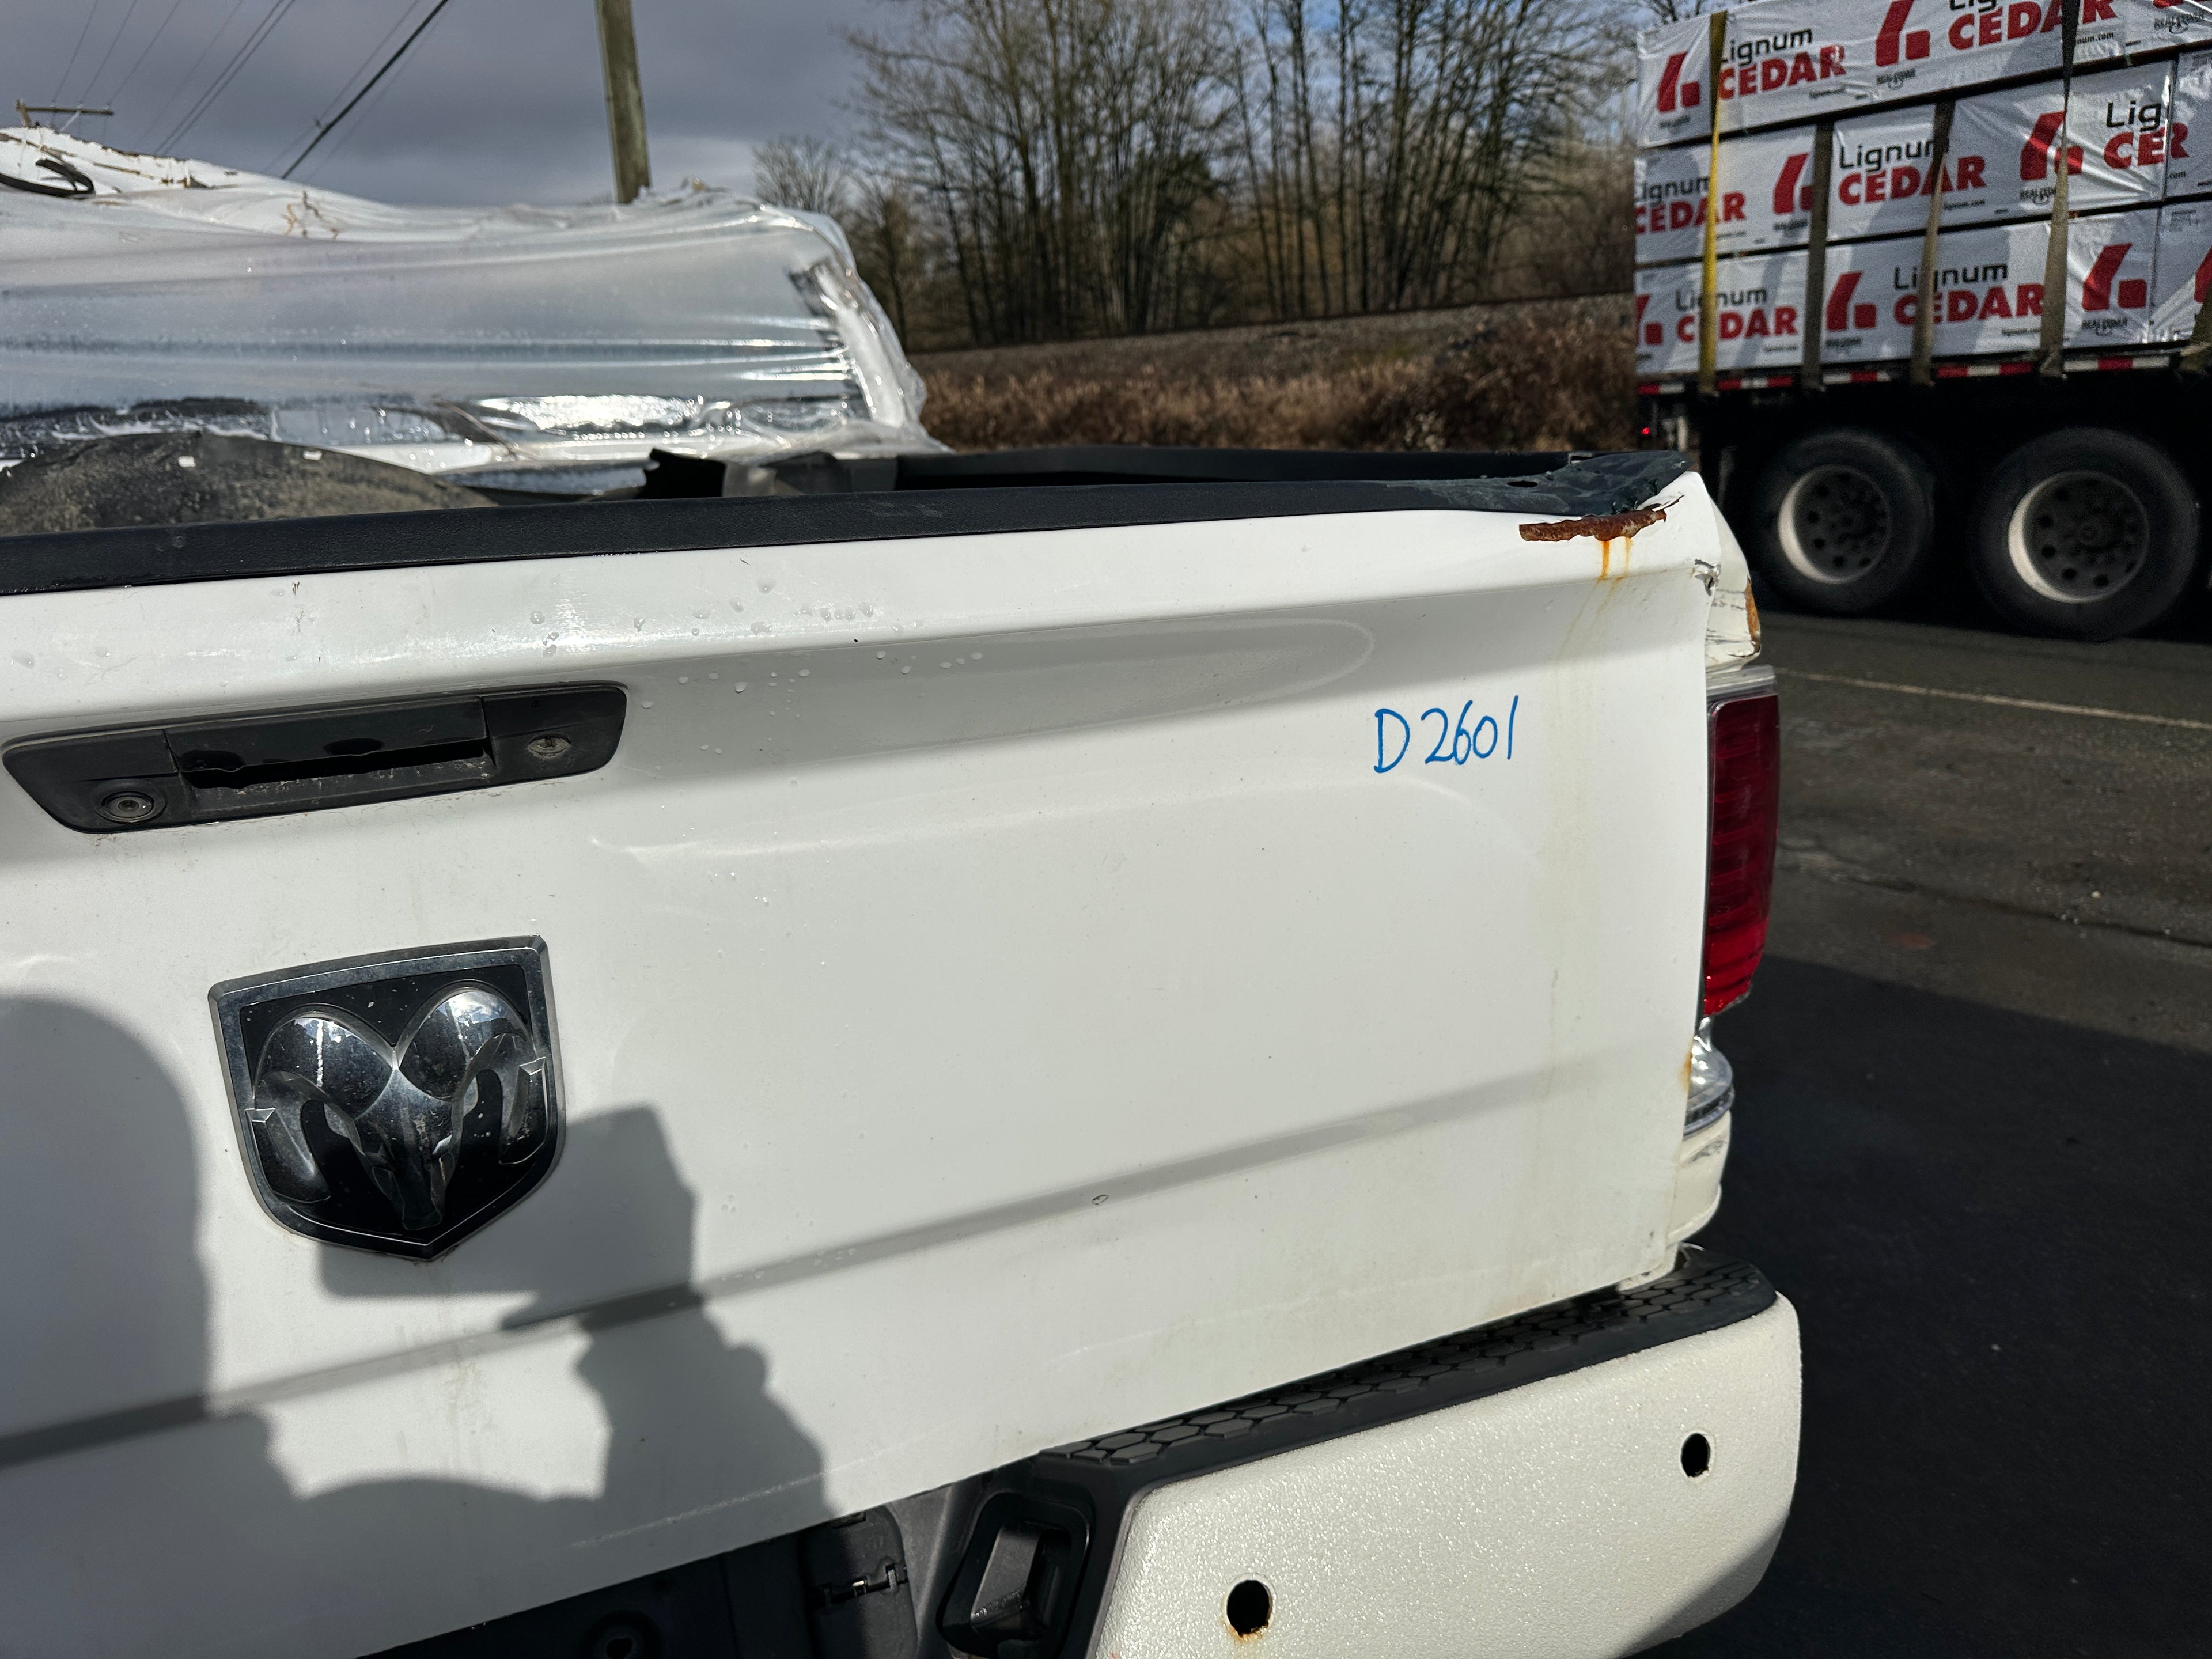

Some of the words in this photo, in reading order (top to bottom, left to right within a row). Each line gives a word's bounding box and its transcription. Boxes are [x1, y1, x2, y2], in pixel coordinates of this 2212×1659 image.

[1721, 28, 1812, 66] ignum
[1718, 44, 1846, 100] CEDAR
[1893, 263, 2008, 292] Linum
[1675, 287, 1767, 312] Linum
[1676, 304, 1798, 344] CDAR
